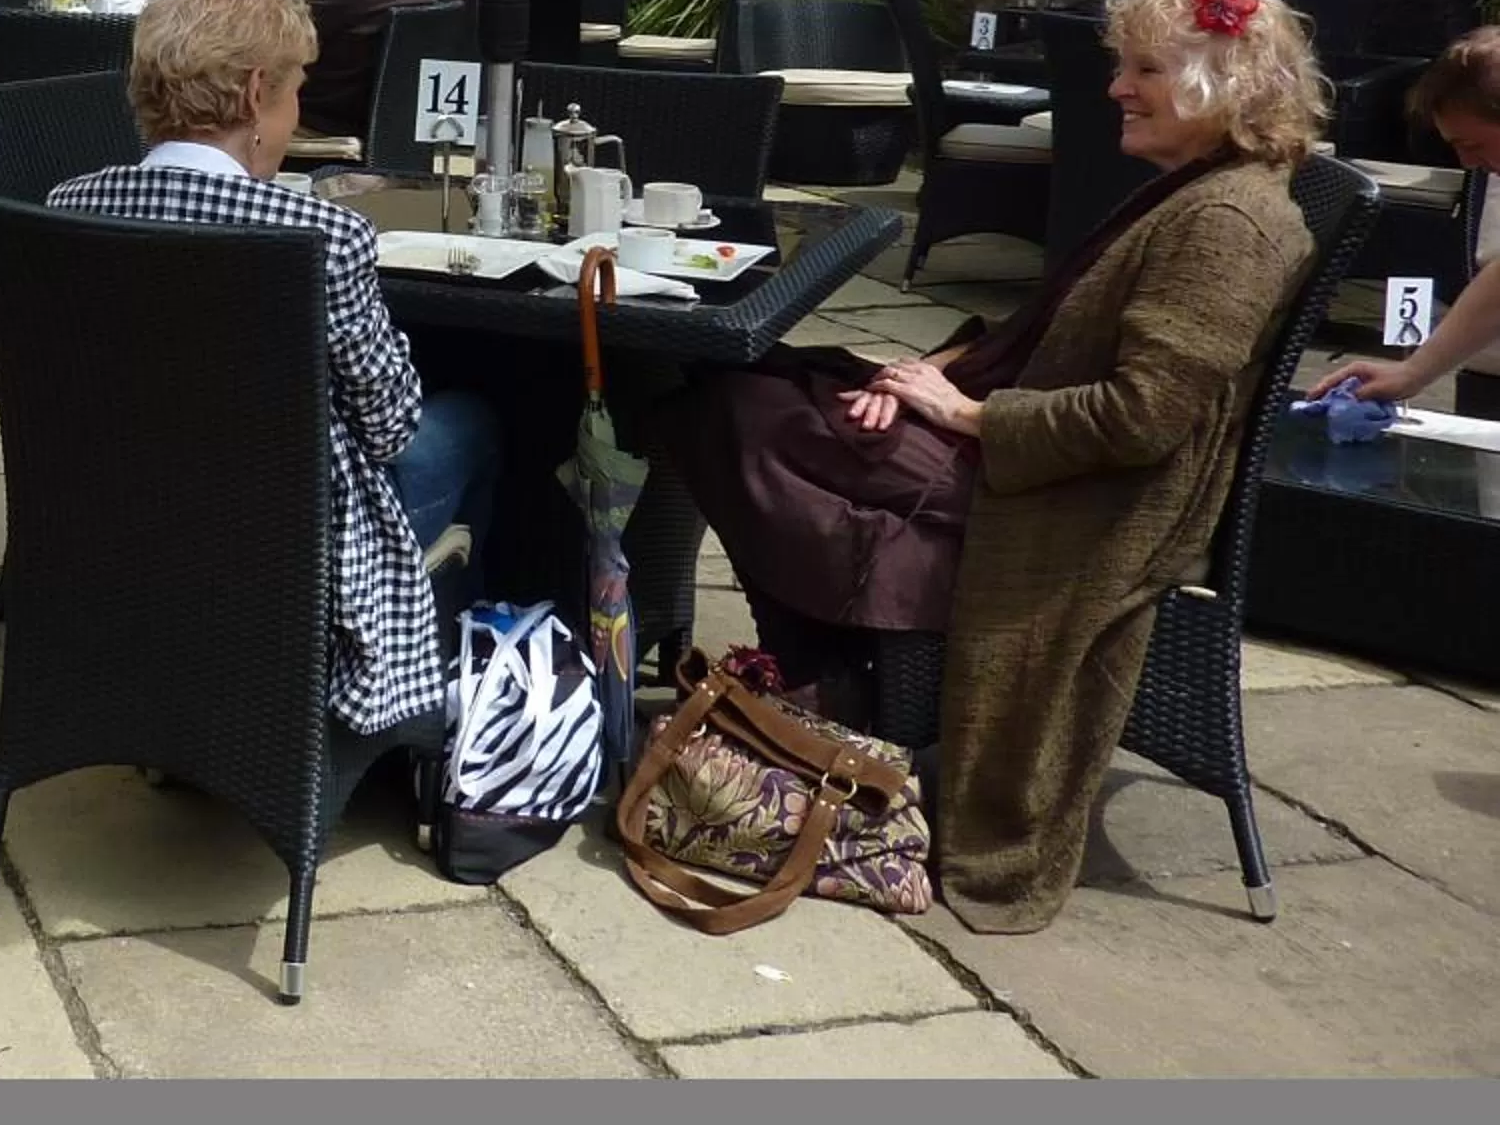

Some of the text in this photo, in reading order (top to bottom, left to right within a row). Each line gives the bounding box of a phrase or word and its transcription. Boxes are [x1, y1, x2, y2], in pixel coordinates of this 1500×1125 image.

[980, 17, 989, 35] 3
[426, 73, 469, 115] 14
[1400, 287, 1418, 320] 5
